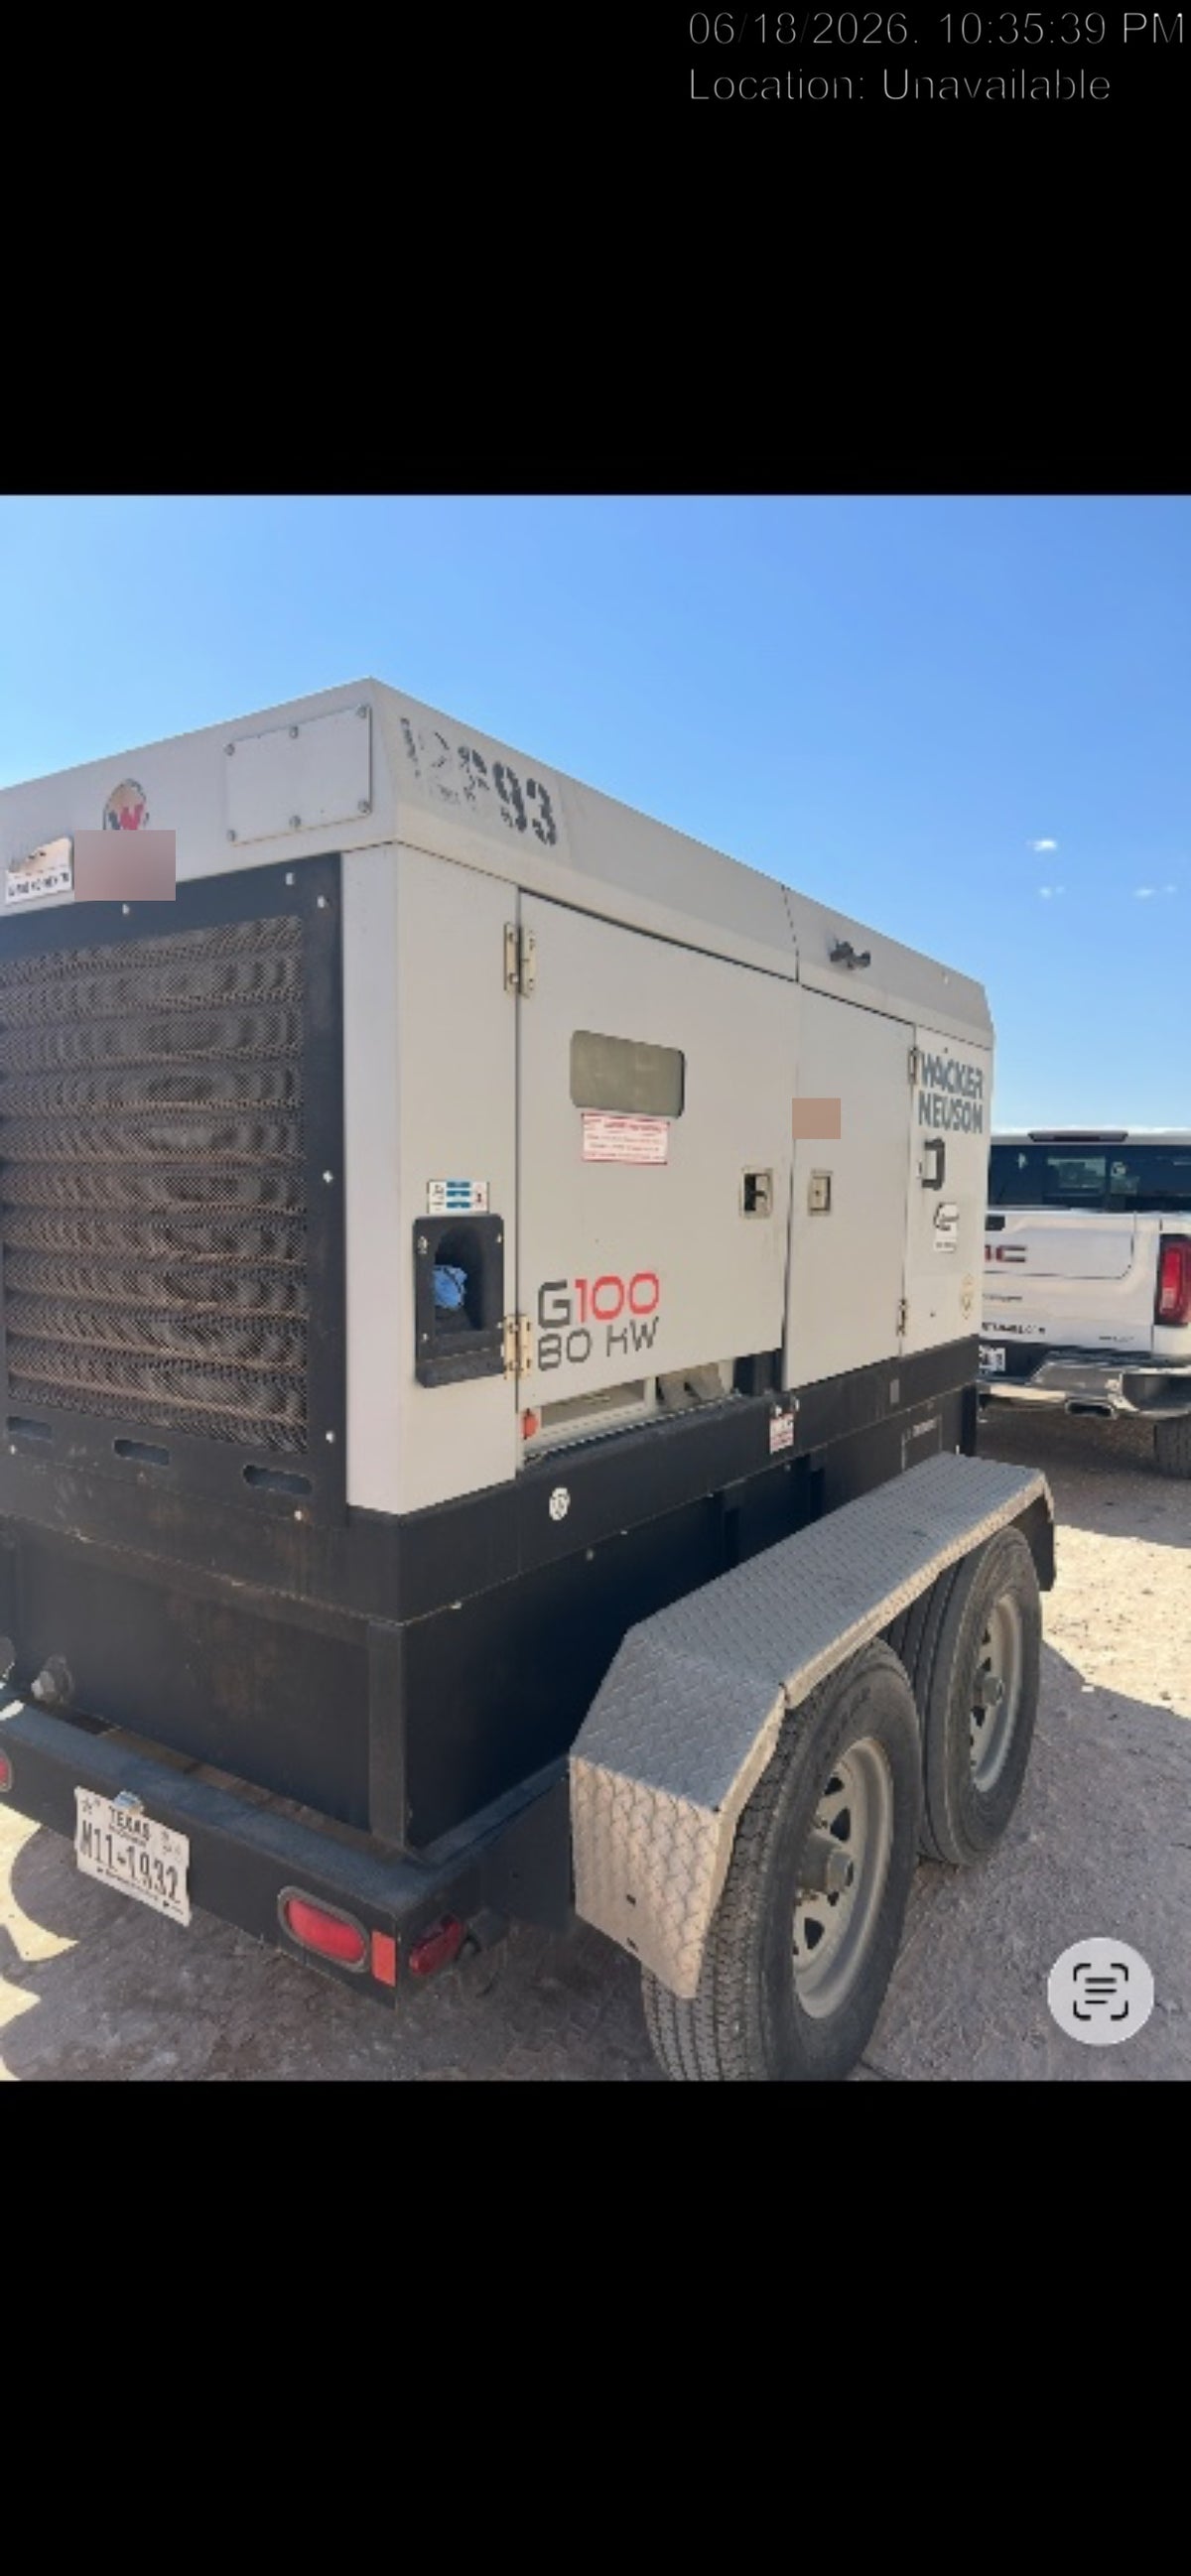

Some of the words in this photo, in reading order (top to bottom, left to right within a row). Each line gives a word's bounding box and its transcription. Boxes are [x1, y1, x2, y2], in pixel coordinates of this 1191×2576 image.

[920, 1052, 983, 1099] WACKER
[918, 1091, 983, 1134] NEUSON
[538, 1272, 660, 1329] G100
[538, 1328, 593, 1371] 80
[108, 1806, 150, 1841] TEXAS
